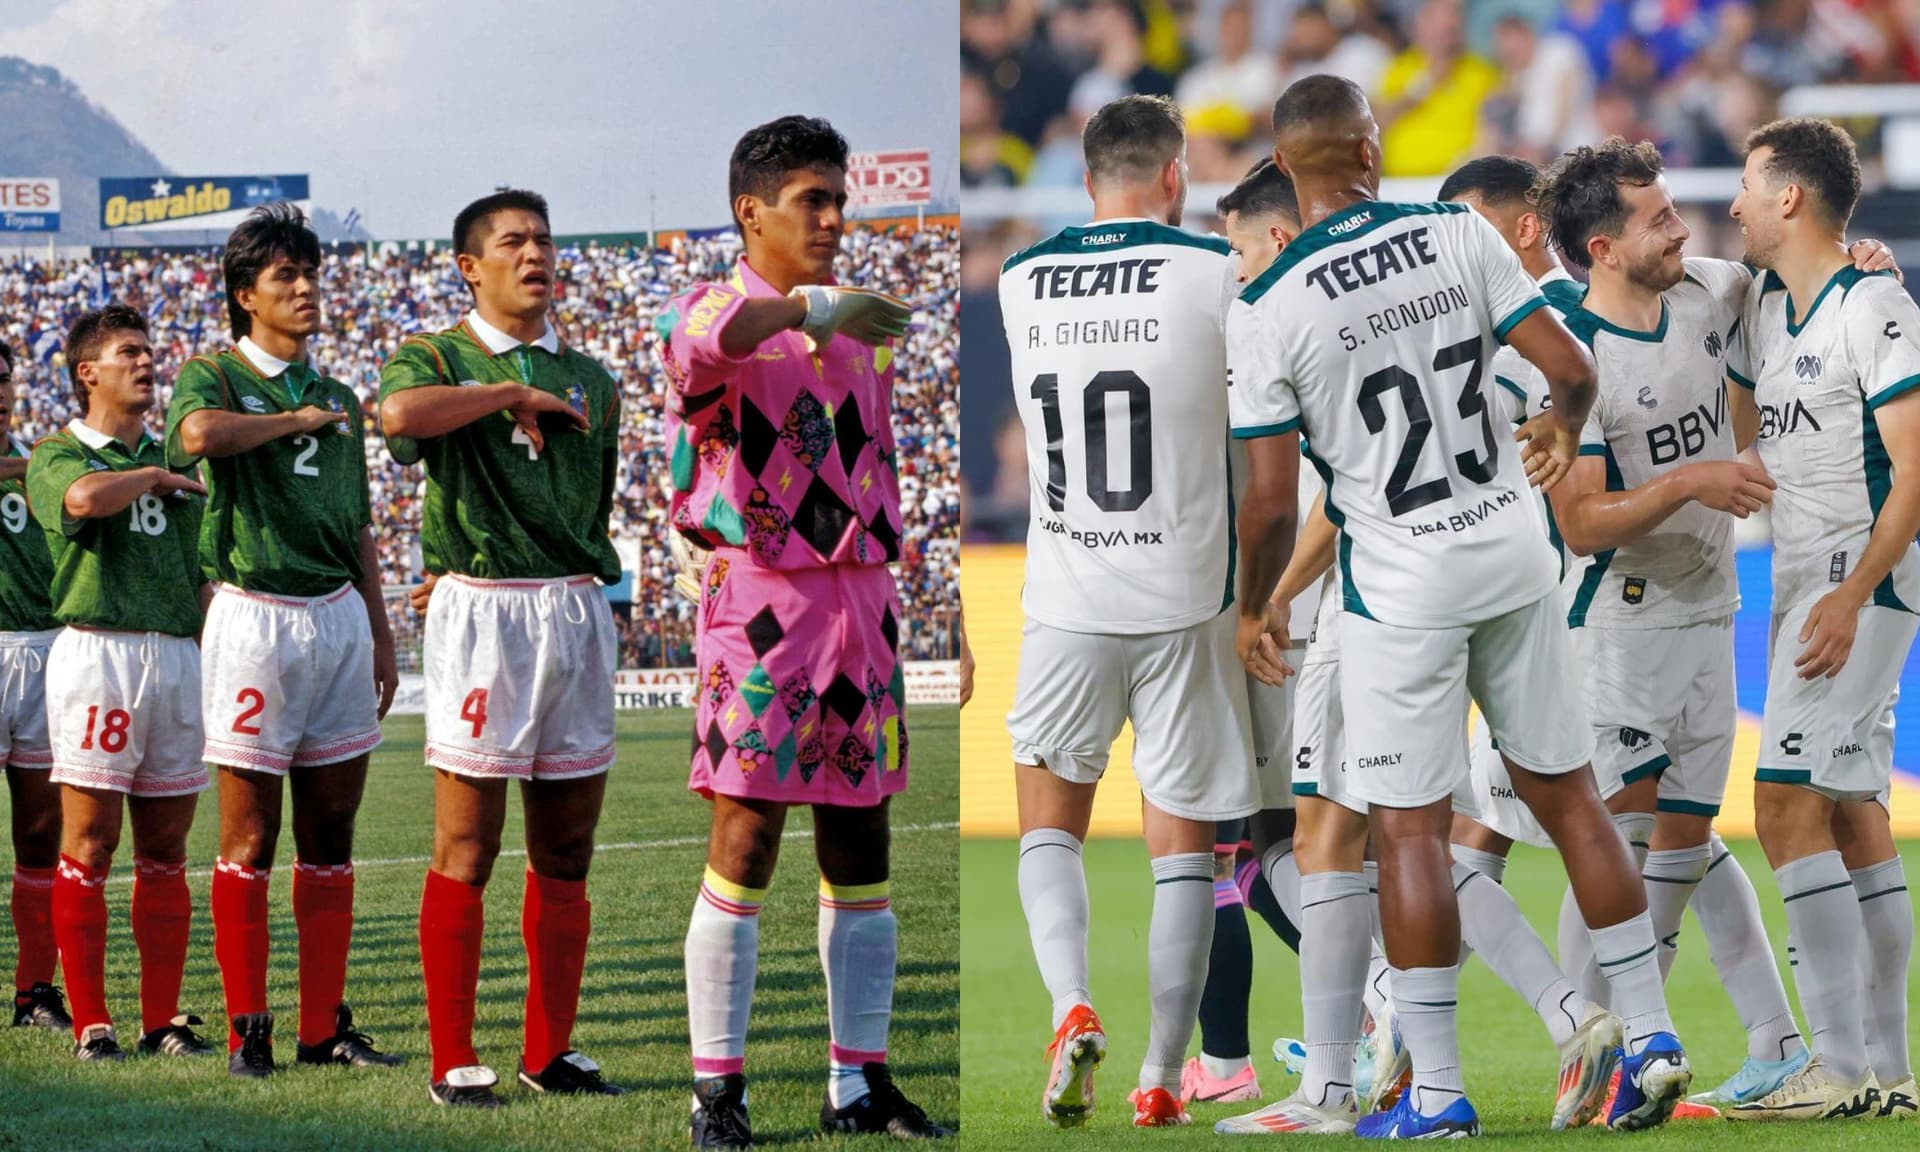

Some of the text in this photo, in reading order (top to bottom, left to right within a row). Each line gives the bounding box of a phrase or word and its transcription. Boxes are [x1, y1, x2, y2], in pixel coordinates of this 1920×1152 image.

[105, 182, 231, 227] Oswaldo
[1328, 211, 1372, 236] CHARLY
[1081, 233, 1128, 245] CHARLY
[1028, 259, 1167, 300] TECATE
[1306, 227, 1437, 300] TECATE
[1028, 319, 1159, 349] A. GIGNAC
[1339, 284, 1469, 352] S. RONDON
[1031, 370, 1152, 512] 10
[1357, 336, 1499, 516] 23
[293, 434, 320, 477] 2
[129, 492, 167, 536] 18
[1411, 490, 1519, 537] LIGA BBVA MX
[1134, 532, 1164, 544] MX
[80, 705, 131, 754] 18
[231, 687, 265, 736] 2
[460, 688, 488, 738] 4
[1358, 753, 1403, 768] CHARLY
